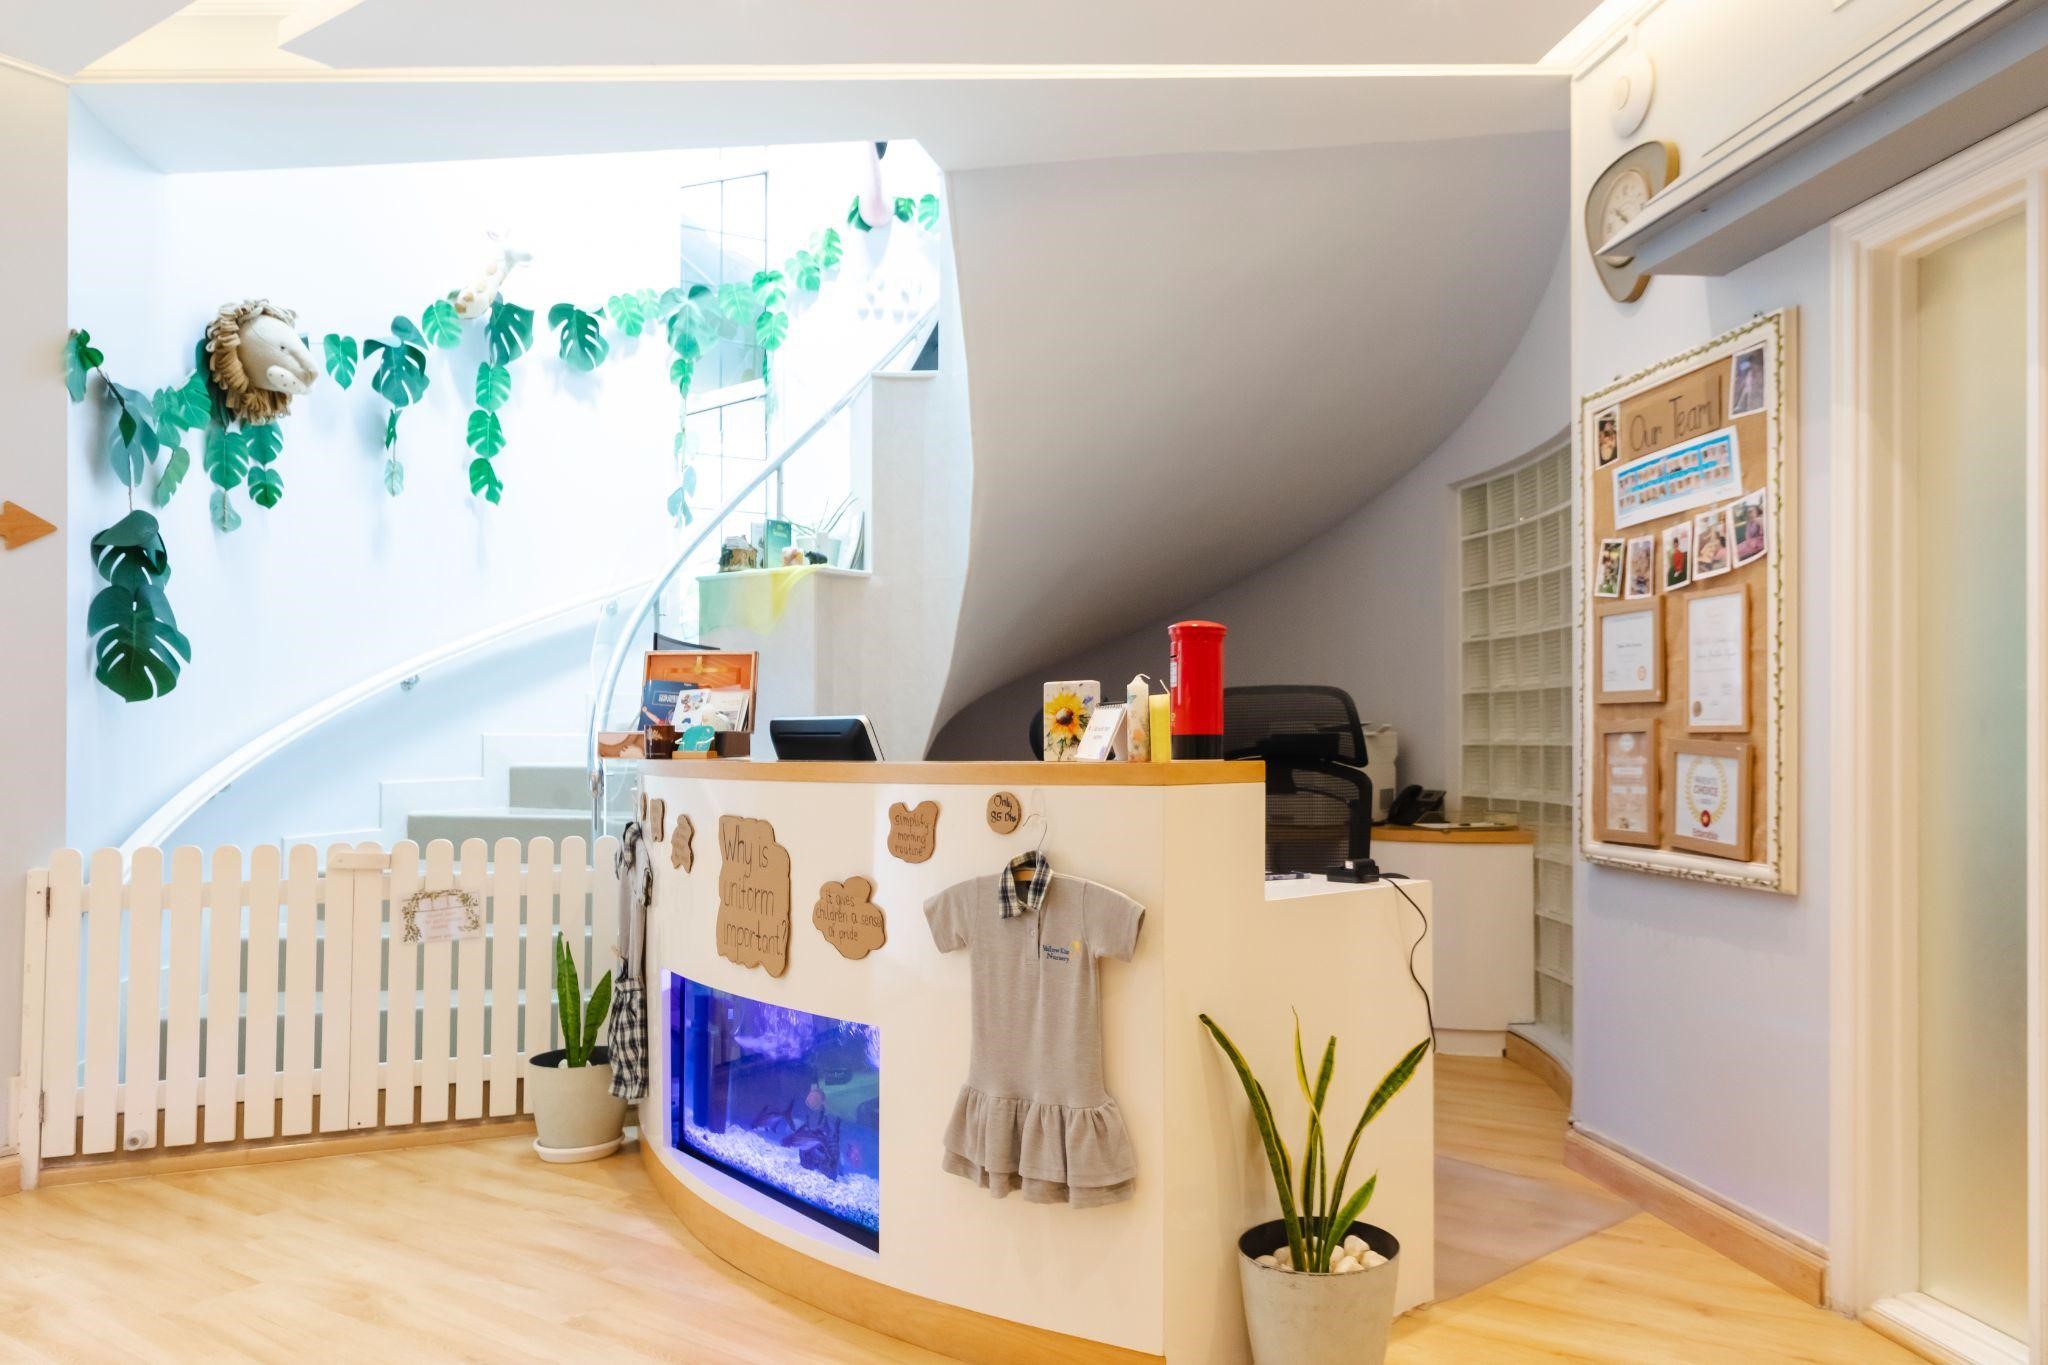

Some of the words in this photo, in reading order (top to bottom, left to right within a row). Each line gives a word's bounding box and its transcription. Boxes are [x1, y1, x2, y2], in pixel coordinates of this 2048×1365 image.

[1630, 414, 1662, 451] Our
[1669, 395, 1714, 439] Team
[993, 794, 1012, 812] Only
[990, 810, 1003, 823] 85
[897, 831, 926, 848] morning
[722, 823, 753, 878] Why
[758, 836, 769, 869] is
[895, 843, 923, 857] routine
[723, 876, 775, 917] uniform
[835, 894, 855, 908] gives
[815, 903, 847, 923] children
[851, 912, 858, 925] a
[861, 914, 883, 928] sense
[828, 922, 835, 938] of
[839, 926, 858, 944] pride
[1047, 952, 1070, 963] Nursery
